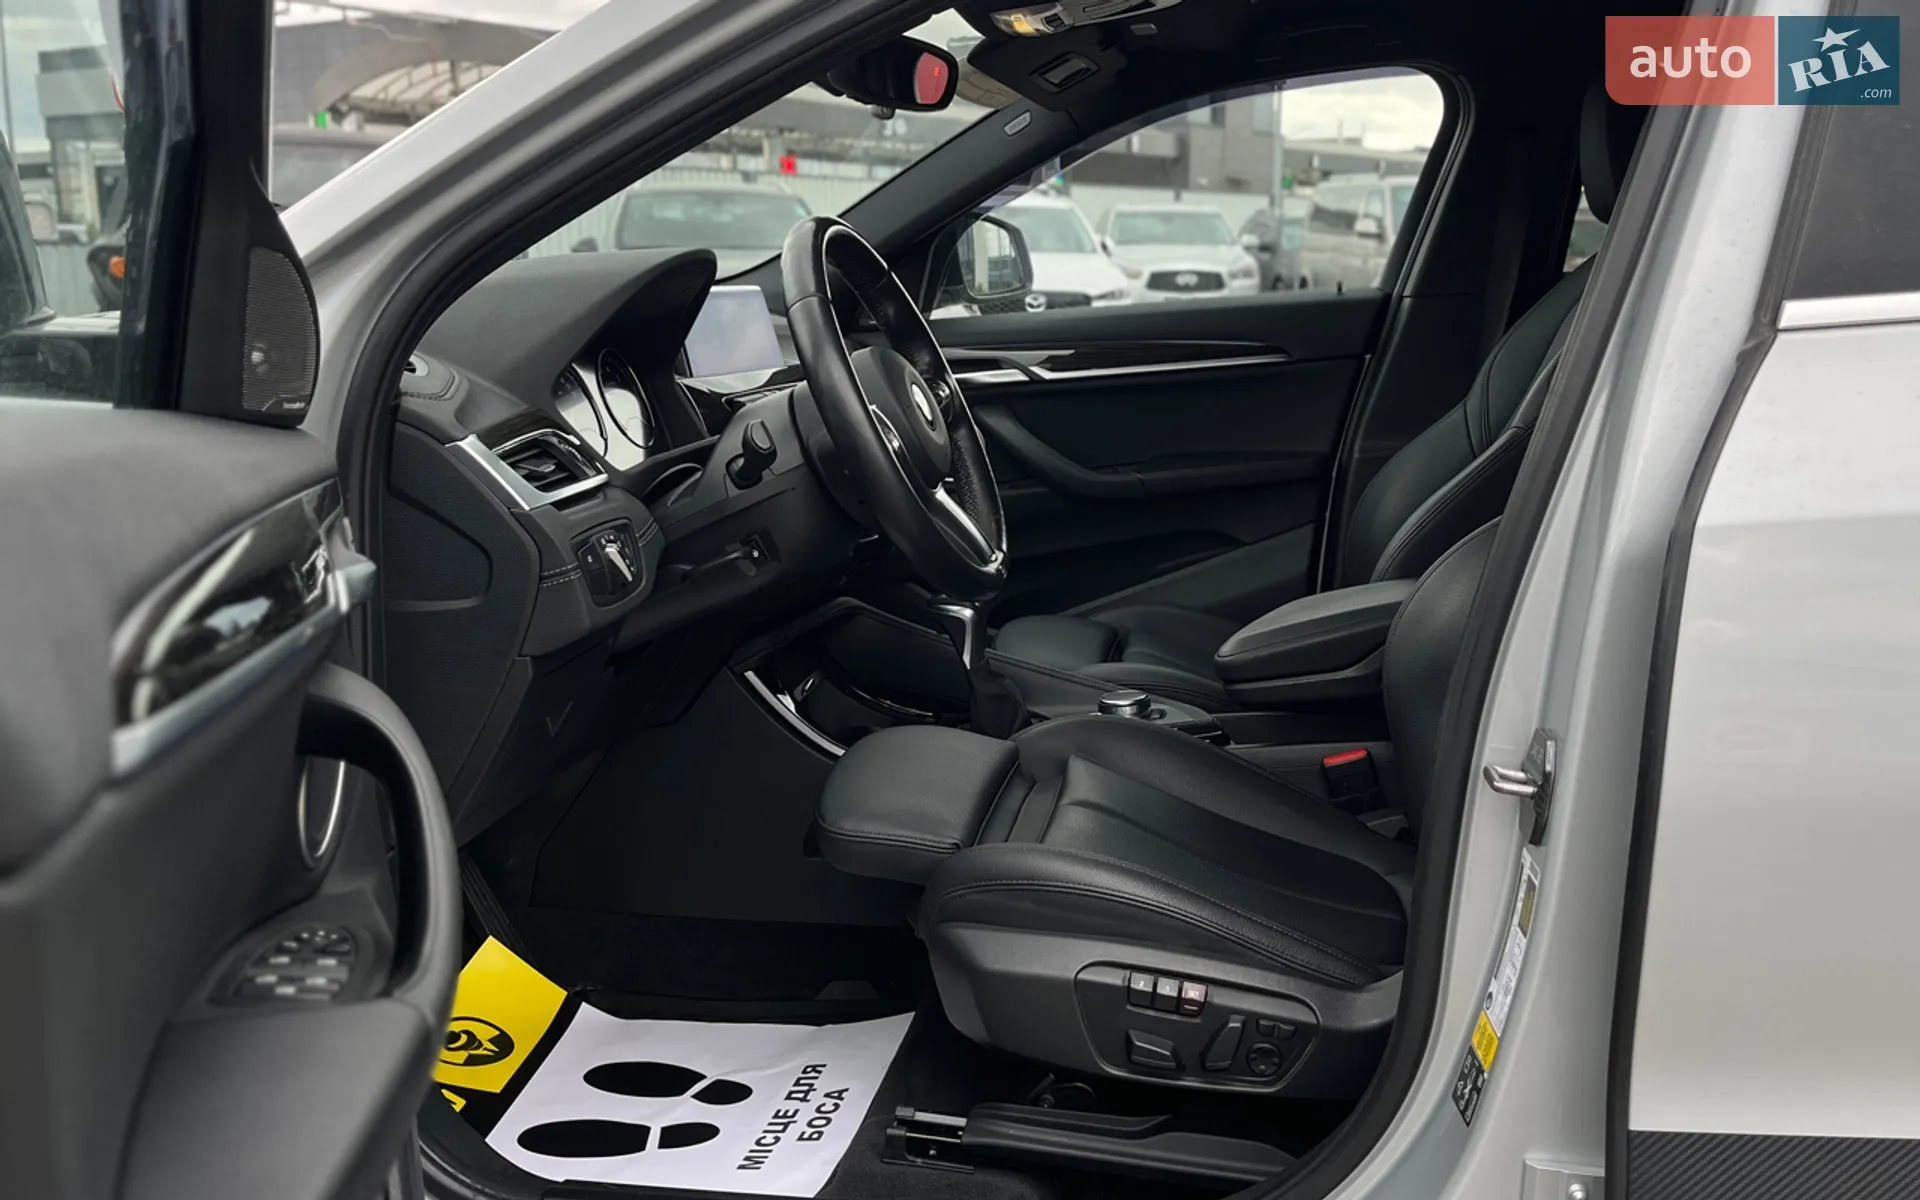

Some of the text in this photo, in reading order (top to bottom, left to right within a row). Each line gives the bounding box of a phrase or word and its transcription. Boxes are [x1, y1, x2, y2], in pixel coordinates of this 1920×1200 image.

[736, 1063, 827, 1170] МІСЦЕ ДЛЯ
[796, 1087, 850, 1141] БОСА
